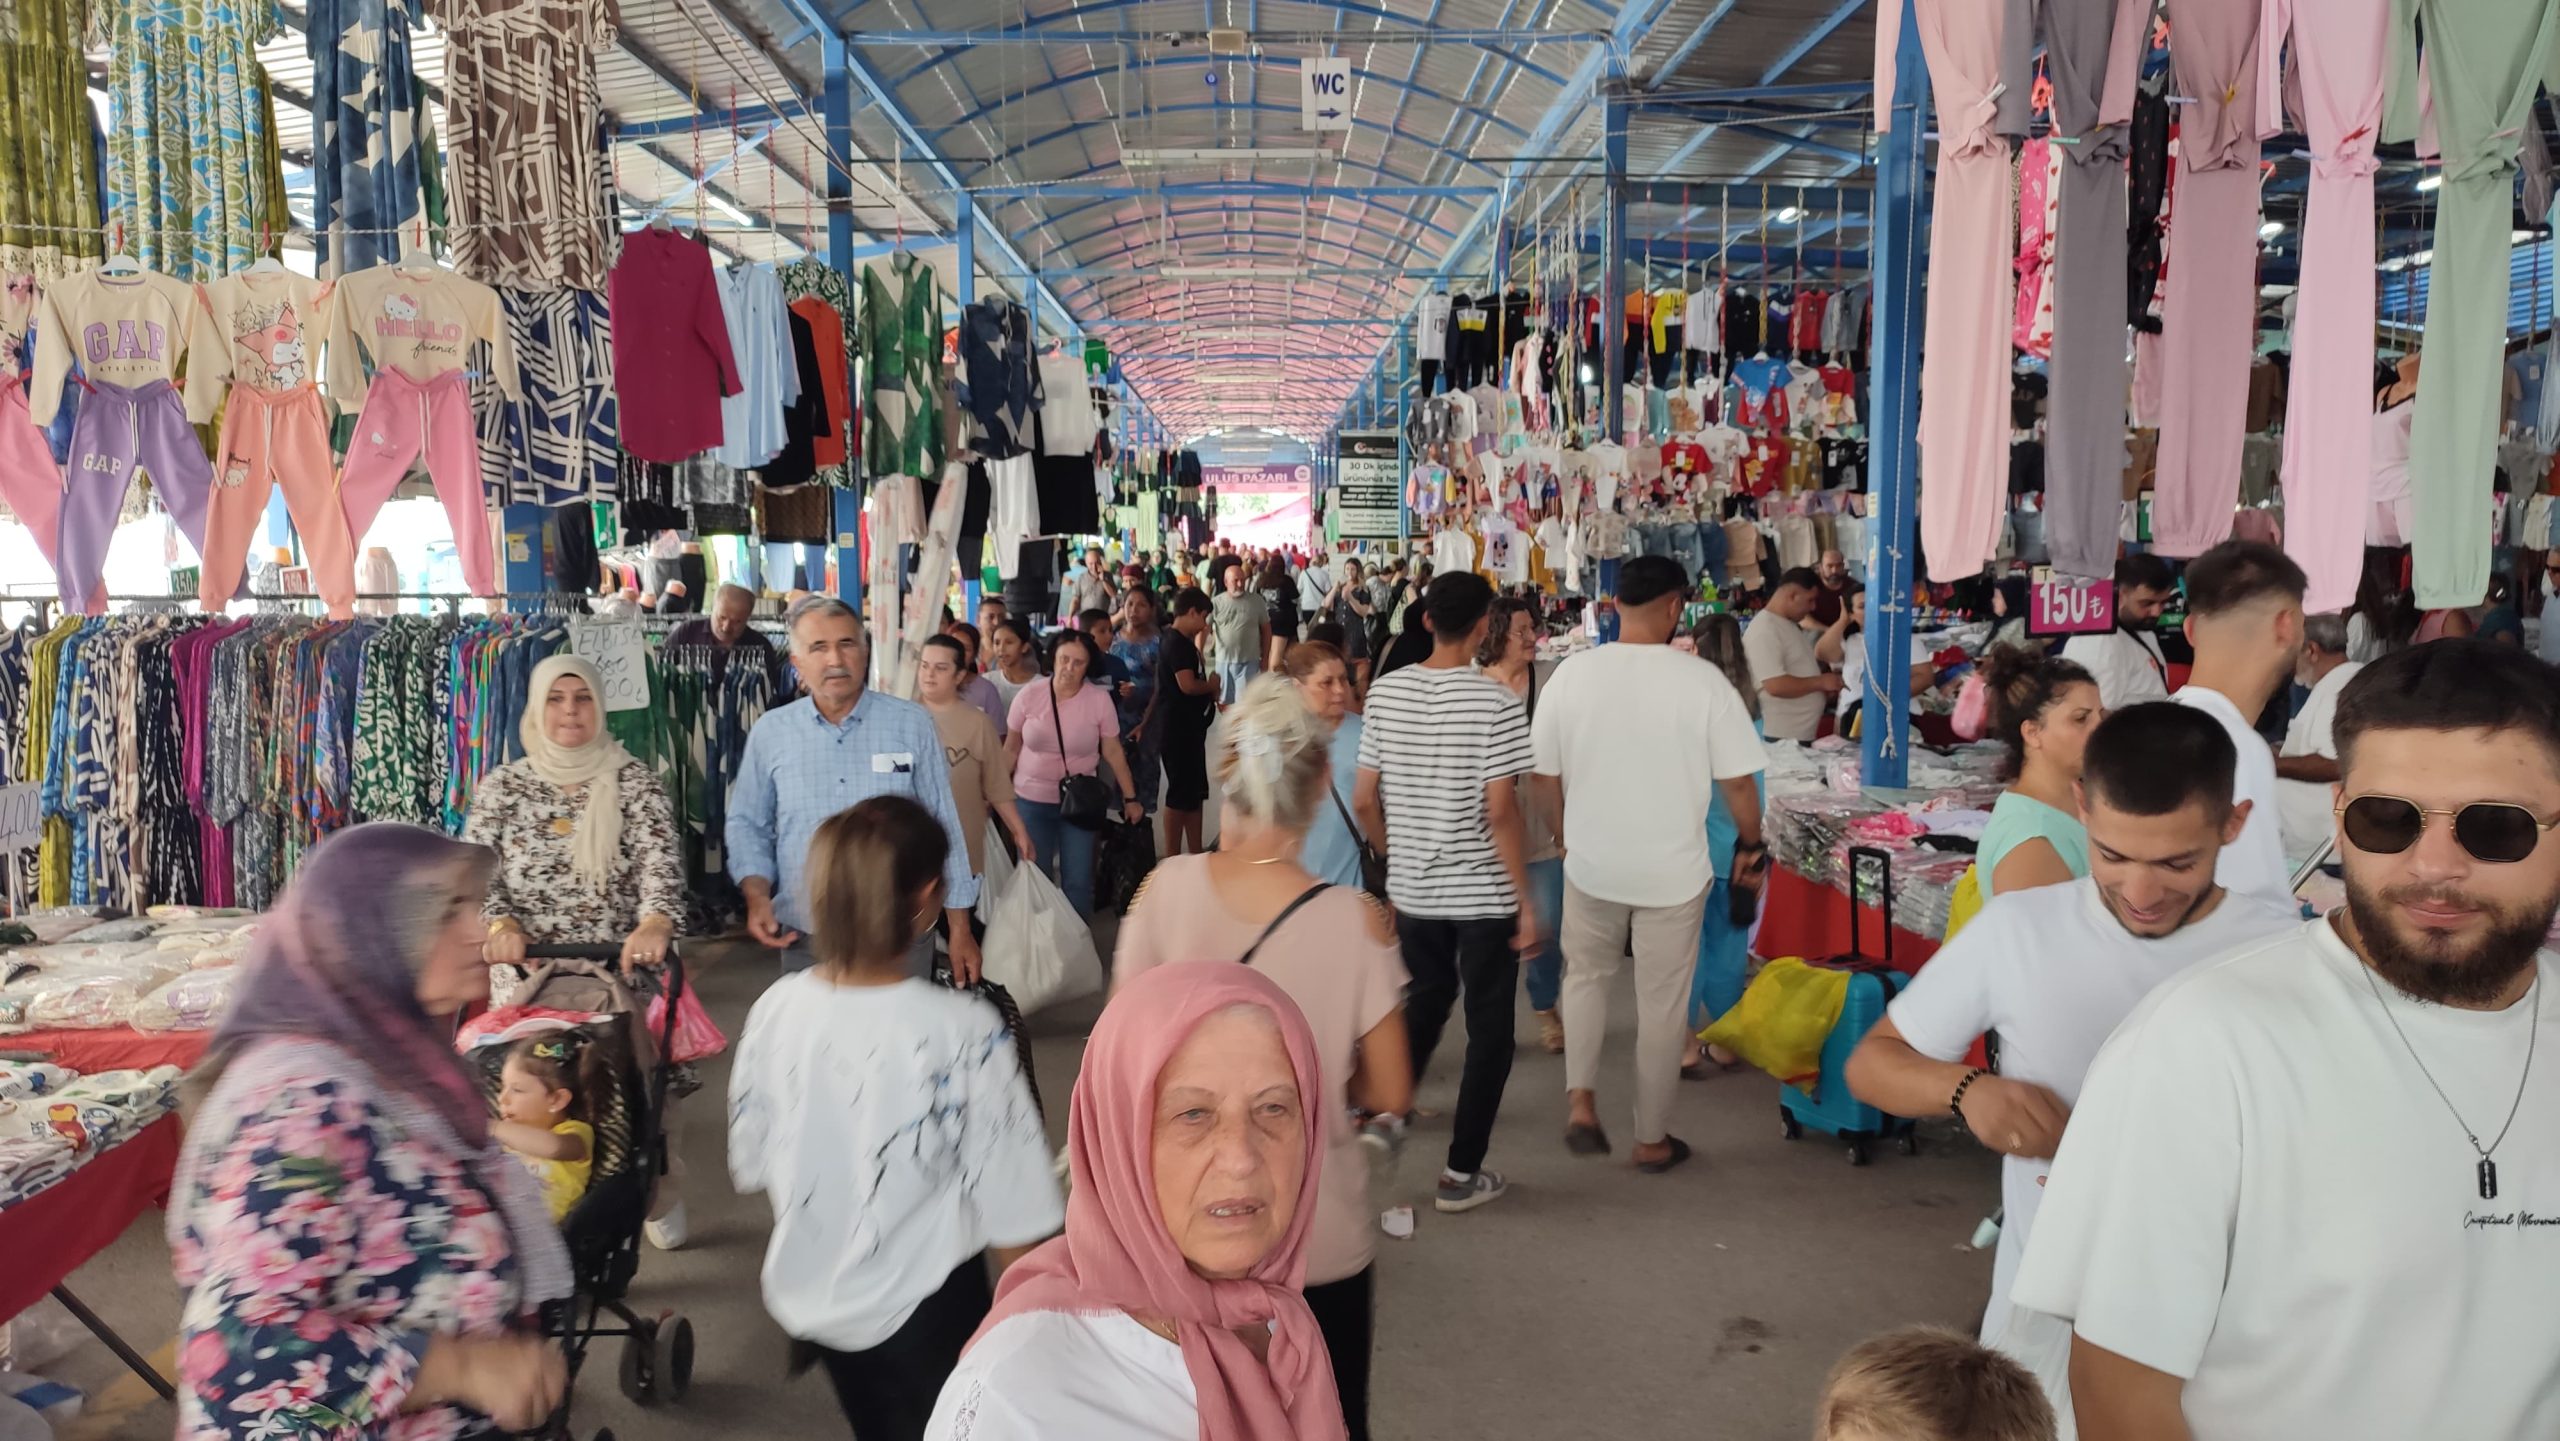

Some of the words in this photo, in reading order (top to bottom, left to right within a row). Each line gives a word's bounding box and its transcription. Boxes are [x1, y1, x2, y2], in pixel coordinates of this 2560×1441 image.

[1312, 73, 1344, 95] WC
[375, 316, 462, 342] HELLO
[83, 319, 166, 364] GAP
[82, 452, 122, 475] GAP
[1242, 472, 1288, 483] PAZARI
